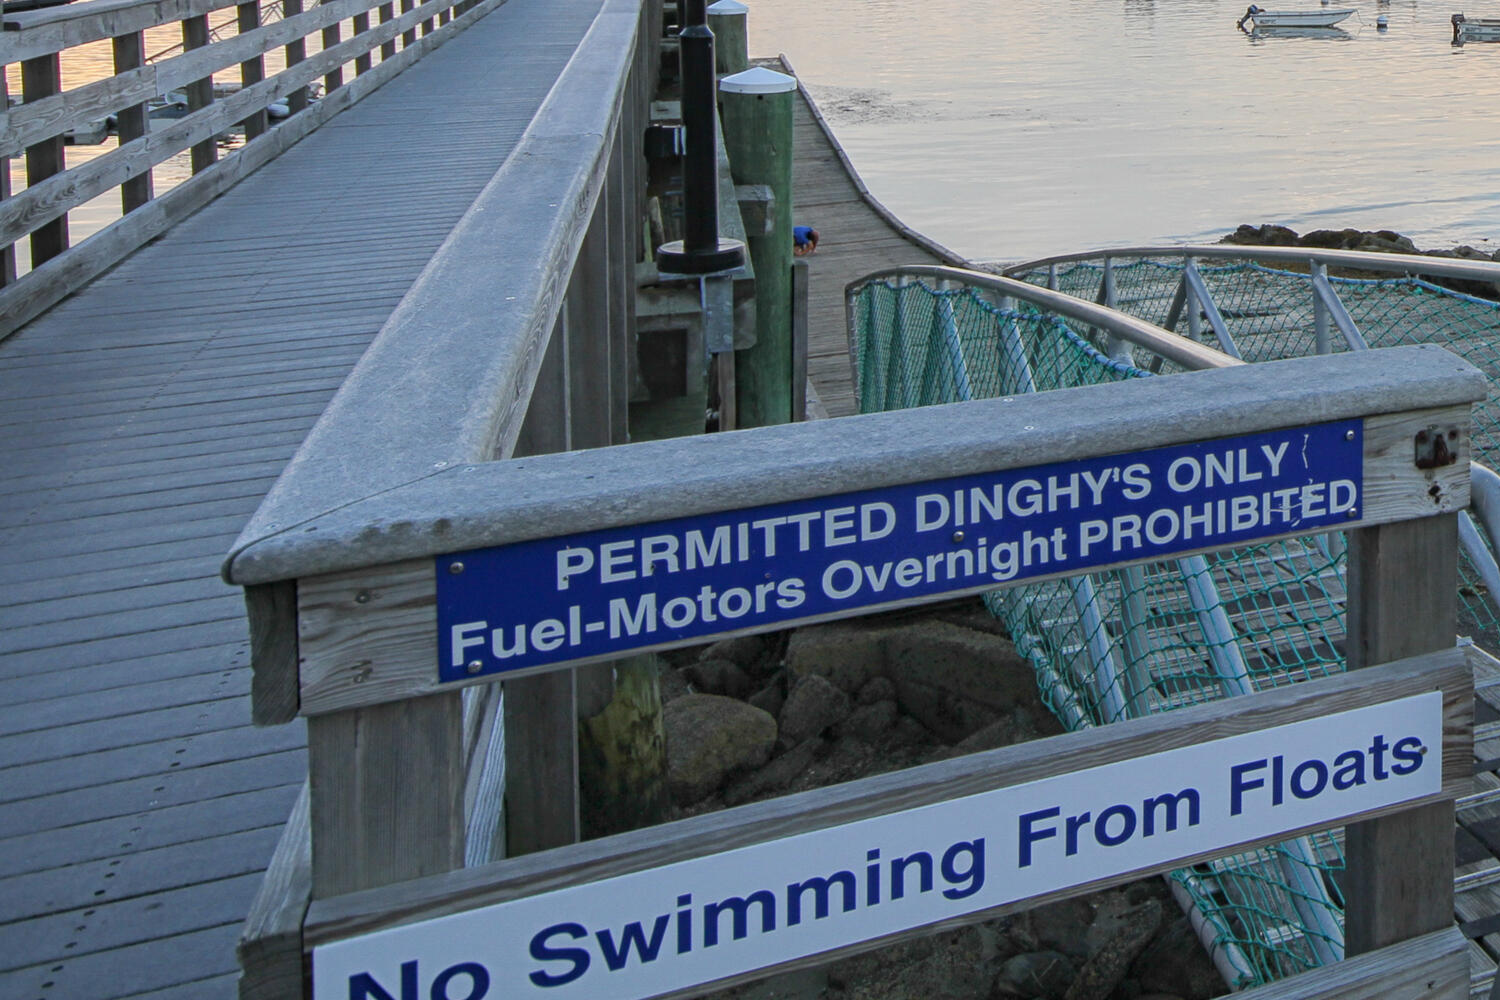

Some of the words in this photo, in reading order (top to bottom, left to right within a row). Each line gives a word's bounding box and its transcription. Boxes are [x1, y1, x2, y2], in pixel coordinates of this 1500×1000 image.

[452, 577, 805, 666] Fuel-Motors
[822, 532, 1067, 599] Overnight
[1080, 479, 1357, 557] PROHIBITED
[557, 501, 896, 591] PERMITTED
[916, 464, 1151, 533] DINGHY'S
[1168, 442, 1289, 491] ONLY
[529, 834, 986, 988] Swimming
[1018, 786, 1200, 868] From
[1230, 734, 1425, 816] Floats
